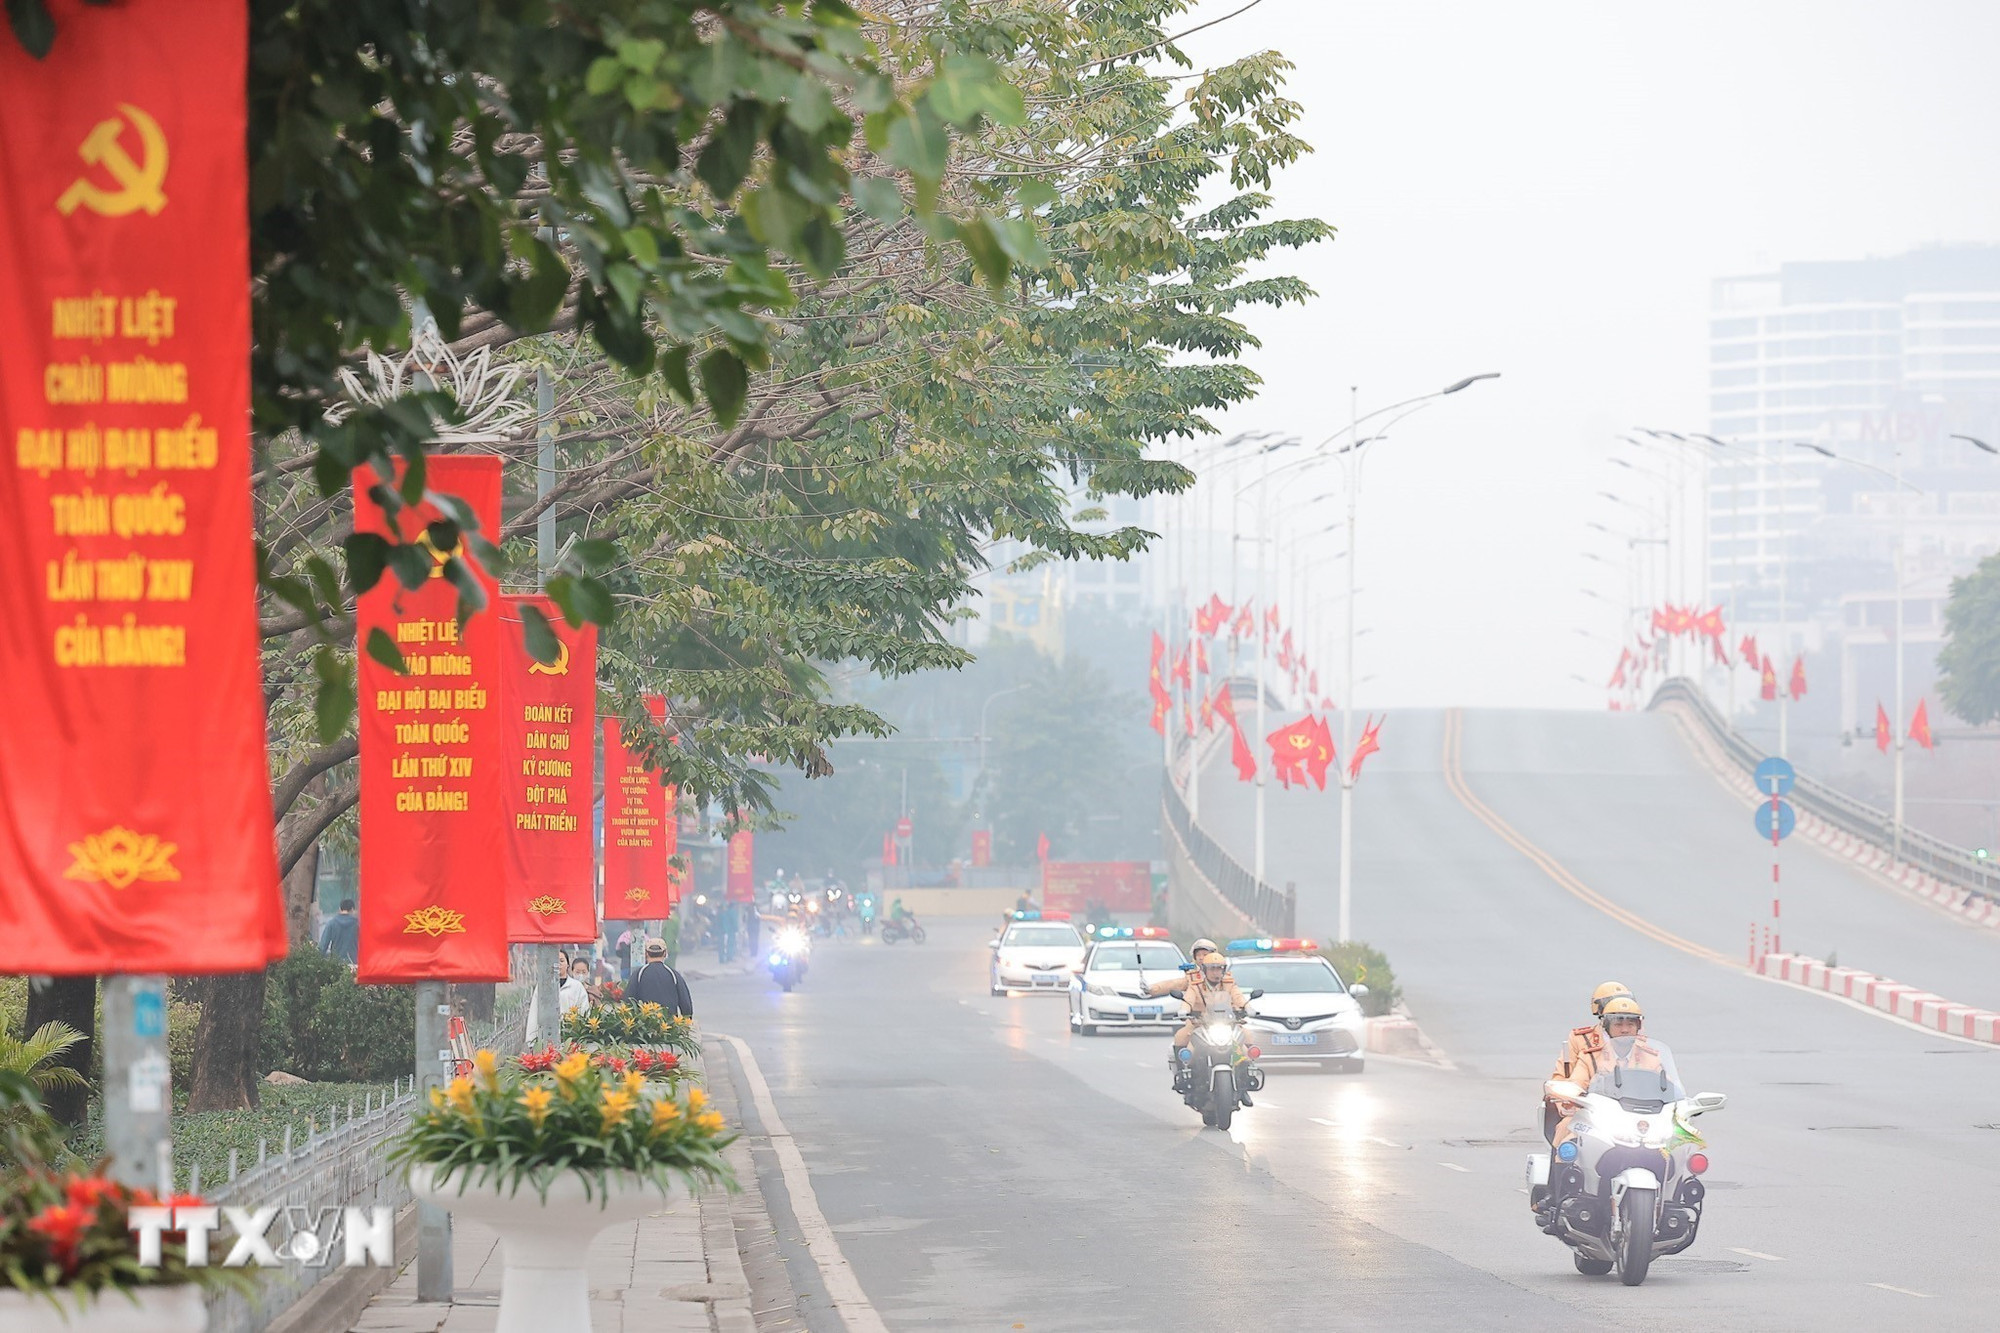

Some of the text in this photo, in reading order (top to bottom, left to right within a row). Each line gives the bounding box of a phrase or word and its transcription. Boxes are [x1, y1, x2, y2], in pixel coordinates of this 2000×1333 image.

[397, 617, 462, 646] NHIỆT LIỆ
[430, 651, 472, 676] MỪNG
[377, 681, 487, 714] ĐẠI HỘI ĐẠI BIỂU
[524, 703, 573, 724] ĐOÀN KẾT
[394, 717, 469, 745] TOÀN QUỐC
[526, 729, 570, 750] DÂN CHỦ
[420, 753, 448, 777] THỨ
[449, 757, 473, 777] XIV
[523, 755, 572, 777] KỶ CƯƠNG
[396, 784, 469, 812] CỦA ĐẢNG!
[526, 784, 567, 807] ĐỘT PHÁ
[516, 810, 577, 832] PHÁT TRIỂN!
